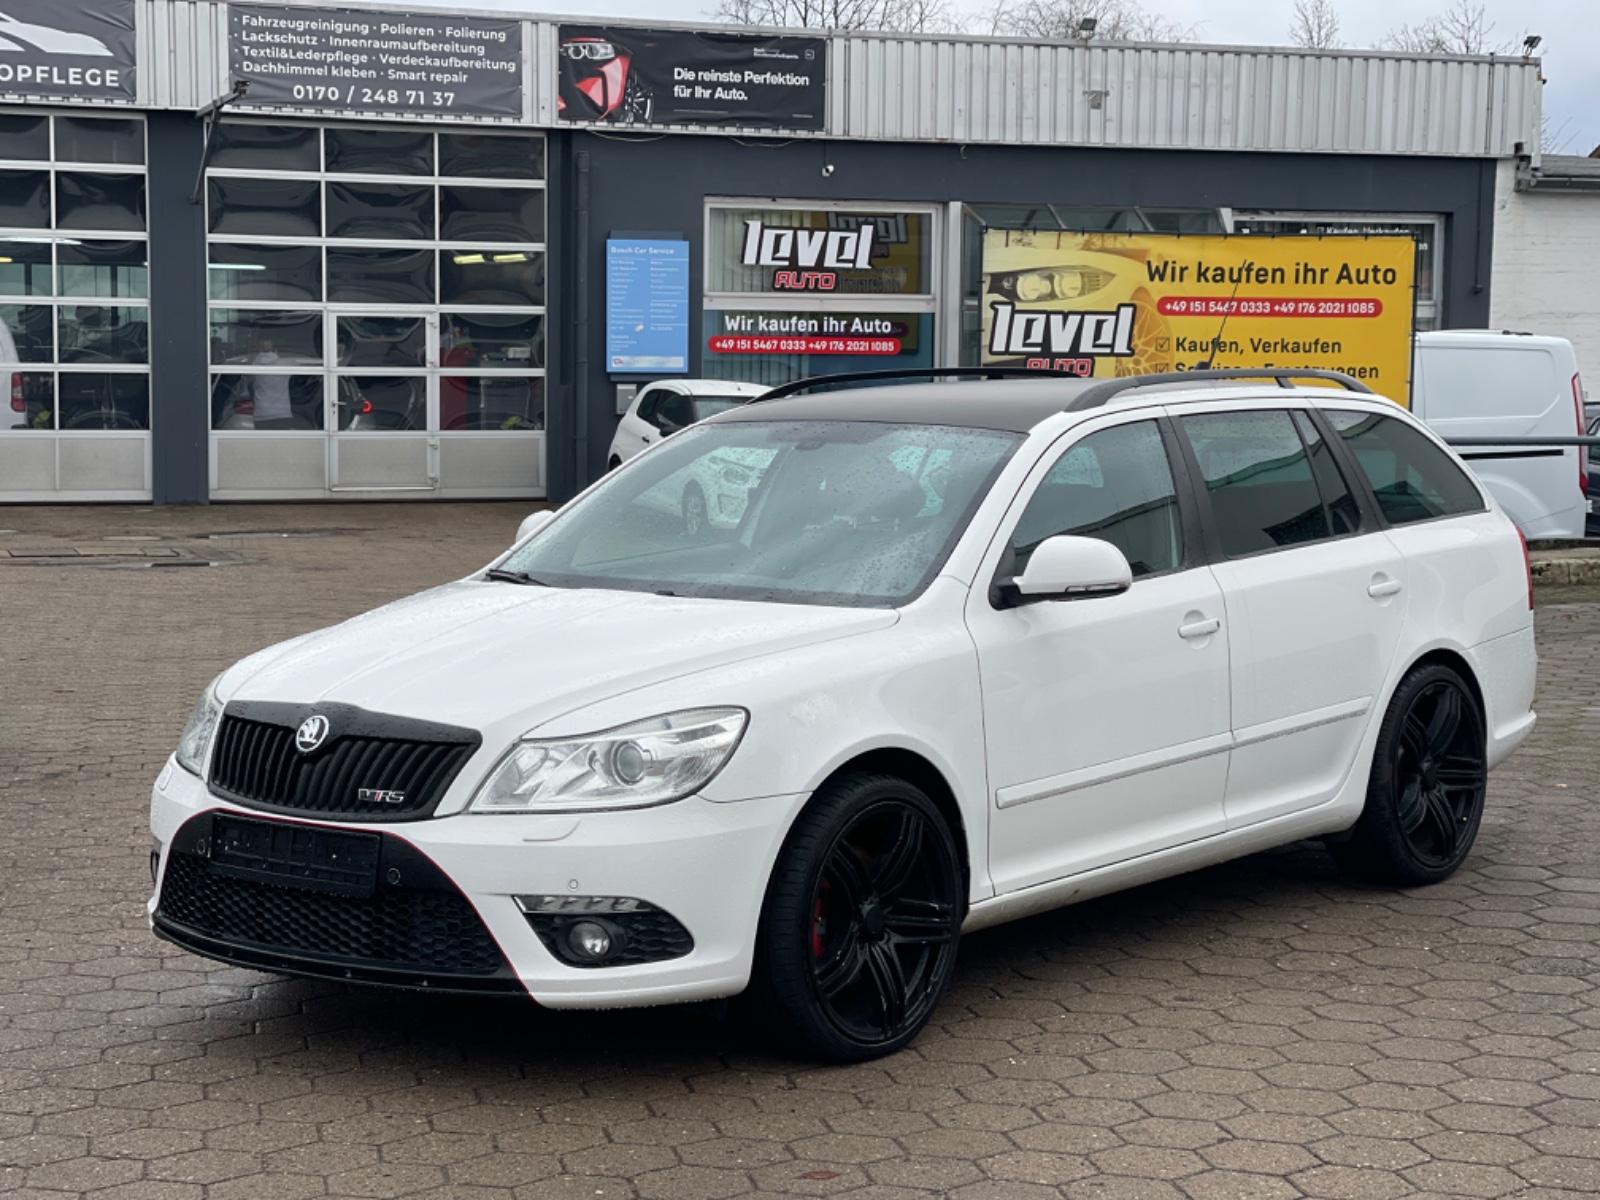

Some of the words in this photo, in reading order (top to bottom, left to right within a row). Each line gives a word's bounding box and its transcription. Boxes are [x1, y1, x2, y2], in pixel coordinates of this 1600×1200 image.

[242, 15, 369, 35] Fahrzeugreinigung
[381, 23, 434, 37] Polieren
[445, 26, 506, 42] Folierung
[242, 30, 318, 45] Lackschutz
[329, 35, 485, 56] Innenraumaufbereitung
[242, 45, 368, 64] Textil&Lederpflege
[379, 53, 516, 72] Verdeckaufbereitung
[0, 63, 120, 87] OPFLEGE
[242, 61, 328, 76] Dachhimmel
[331, 66, 377, 79] kleben
[388, 69, 427, 81] Smart
[430, 71, 468, 84] repair
[674, 67, 696, 81] Die
[698, 69, 742, 83] reinste
[743, 71, 810, 86] Perfektion
[293, 85, 339, 100] 0170
[362, 88, 399, 104] 248
[405, 90, 425, 105] 71
[432, 91, 455, 106] 37
[673, 84, 693, 98] für
[694, 85, 712, 99] Ihr
[714, 86, 748, 100] Auto.
[743, 219, 874, 270] level
[774, 271, 836, 290] AUTO
[1146, 260, 1189, 283] Wir
[1196, 260, 1285, 284] kaufen
[1294, 262, 1329, 285] ihr
[1335, 263, 1397, 285] Auto
[1165, 301, 1187, 312] +49
[1189, 301, 1206, 312] 151
[1240, 301, 1271, 313] 0333
[1273, 302, 1295, 313] +49
[1297, 302, 1316, 313] 176
[1318, 302, 1345, 313] 2021
[1347, 302, 1375, 313] 1085
[724, 315, 754, 331] Wir
[759, 315, 819, 332] kaufen
[823, 316, 847, 333] ihr
[850, 317, 892, 333] Auto
[991, 303, 1135, 354] level
[715, 339, 734, 349] +49
[736, 339, 751, 349] 151
[753, 339, 779, 350] 5467
[780, 340, 806, 350] 0333
[808, 340, 827, 350] +49
[829, 341, 845, 350] 176
[846, 341, 869, 351] 2021
[871, 341, 895, 352] 1085
[1249, 337, 1342, 353] Verkaufen
